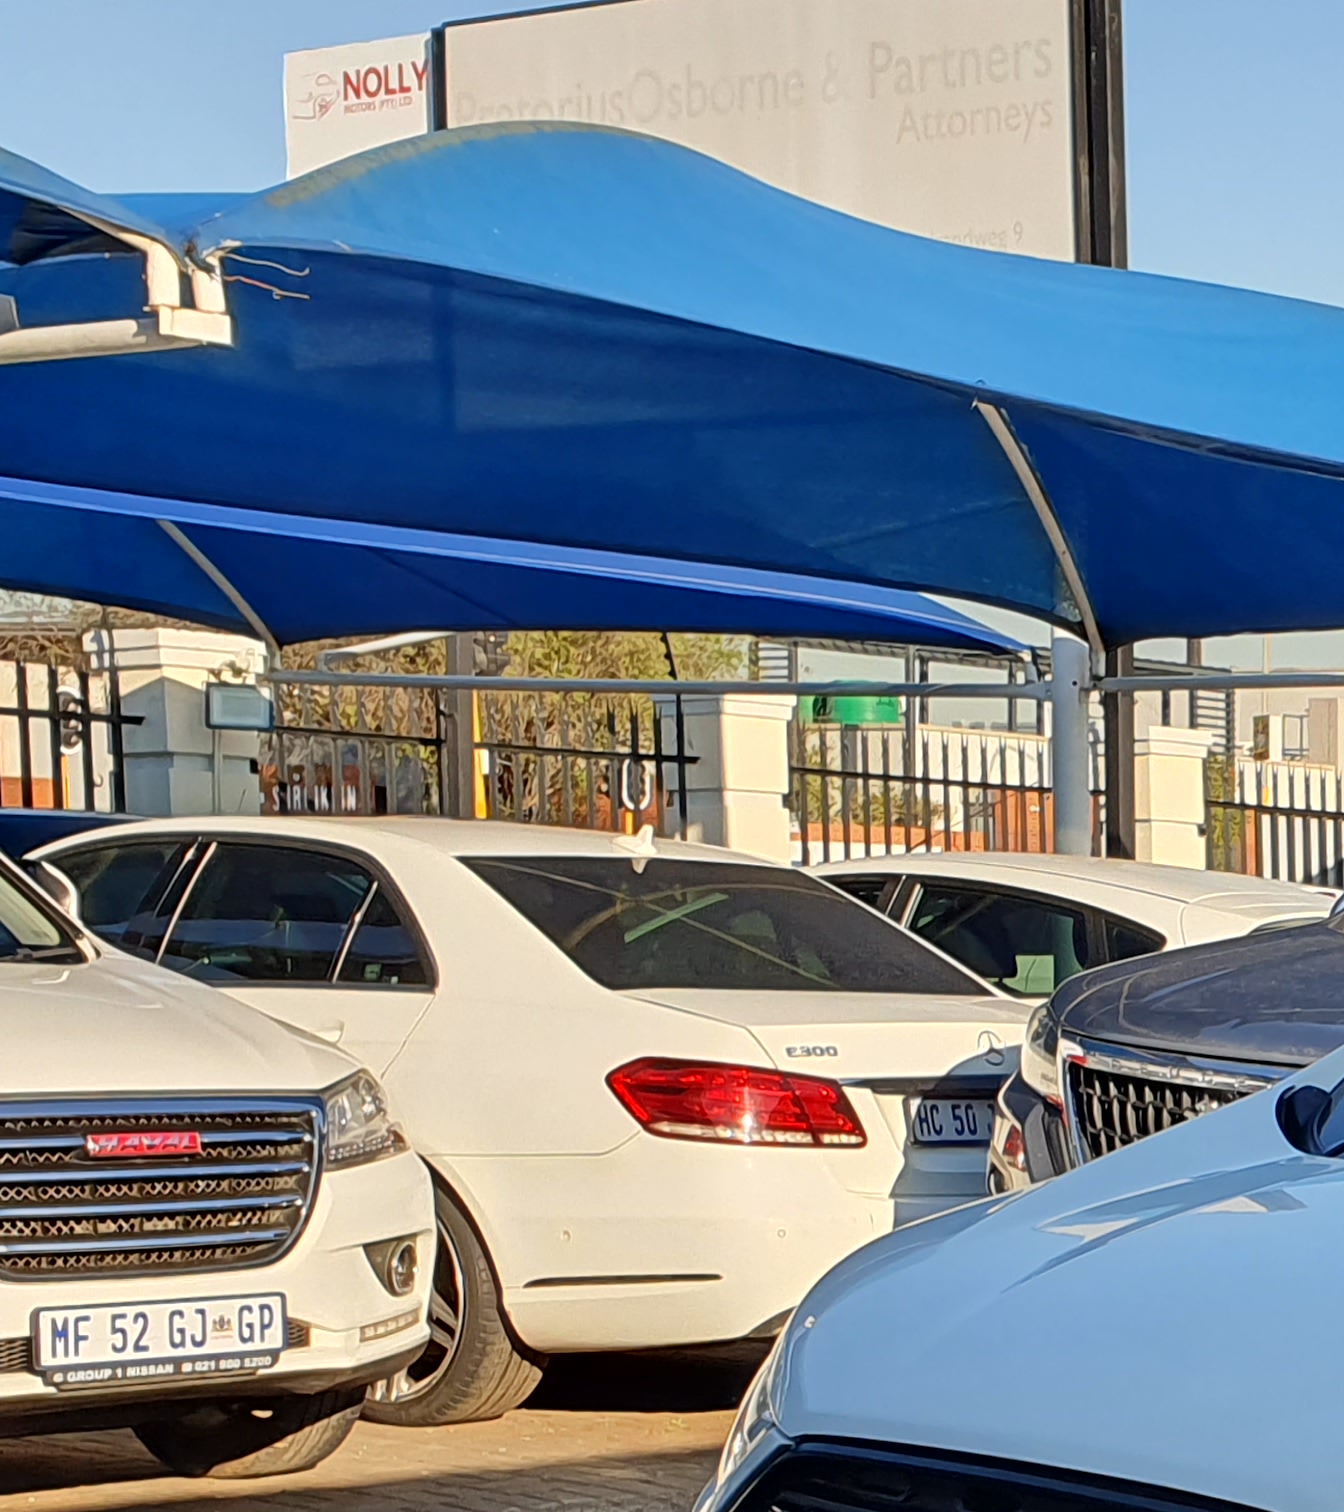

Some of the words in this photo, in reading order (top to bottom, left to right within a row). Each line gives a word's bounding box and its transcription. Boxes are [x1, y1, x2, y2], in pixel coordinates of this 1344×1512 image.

[343, 60, 428, 101] NOLLY
[868, 38, 1053, 100] Partners
[895, 100, 1053, 145] Attorneys
[786, 1045, 838, 1058] E300
[918, 1103, 943, 1138] HC
[951, 1103, 978, 1137] 50
[97, 1134, 198, 1152] HAVAL
[50, 1315, 92, 1359] MF
[110, 1311, 150, 1354] 52
[168, 1308, 207, 1350] GJ
[237, 1304, 274, 1344] GP
[67, 1368, 112, 1382] GROUP
[126, 1364, 174, 1377] NISSAN
